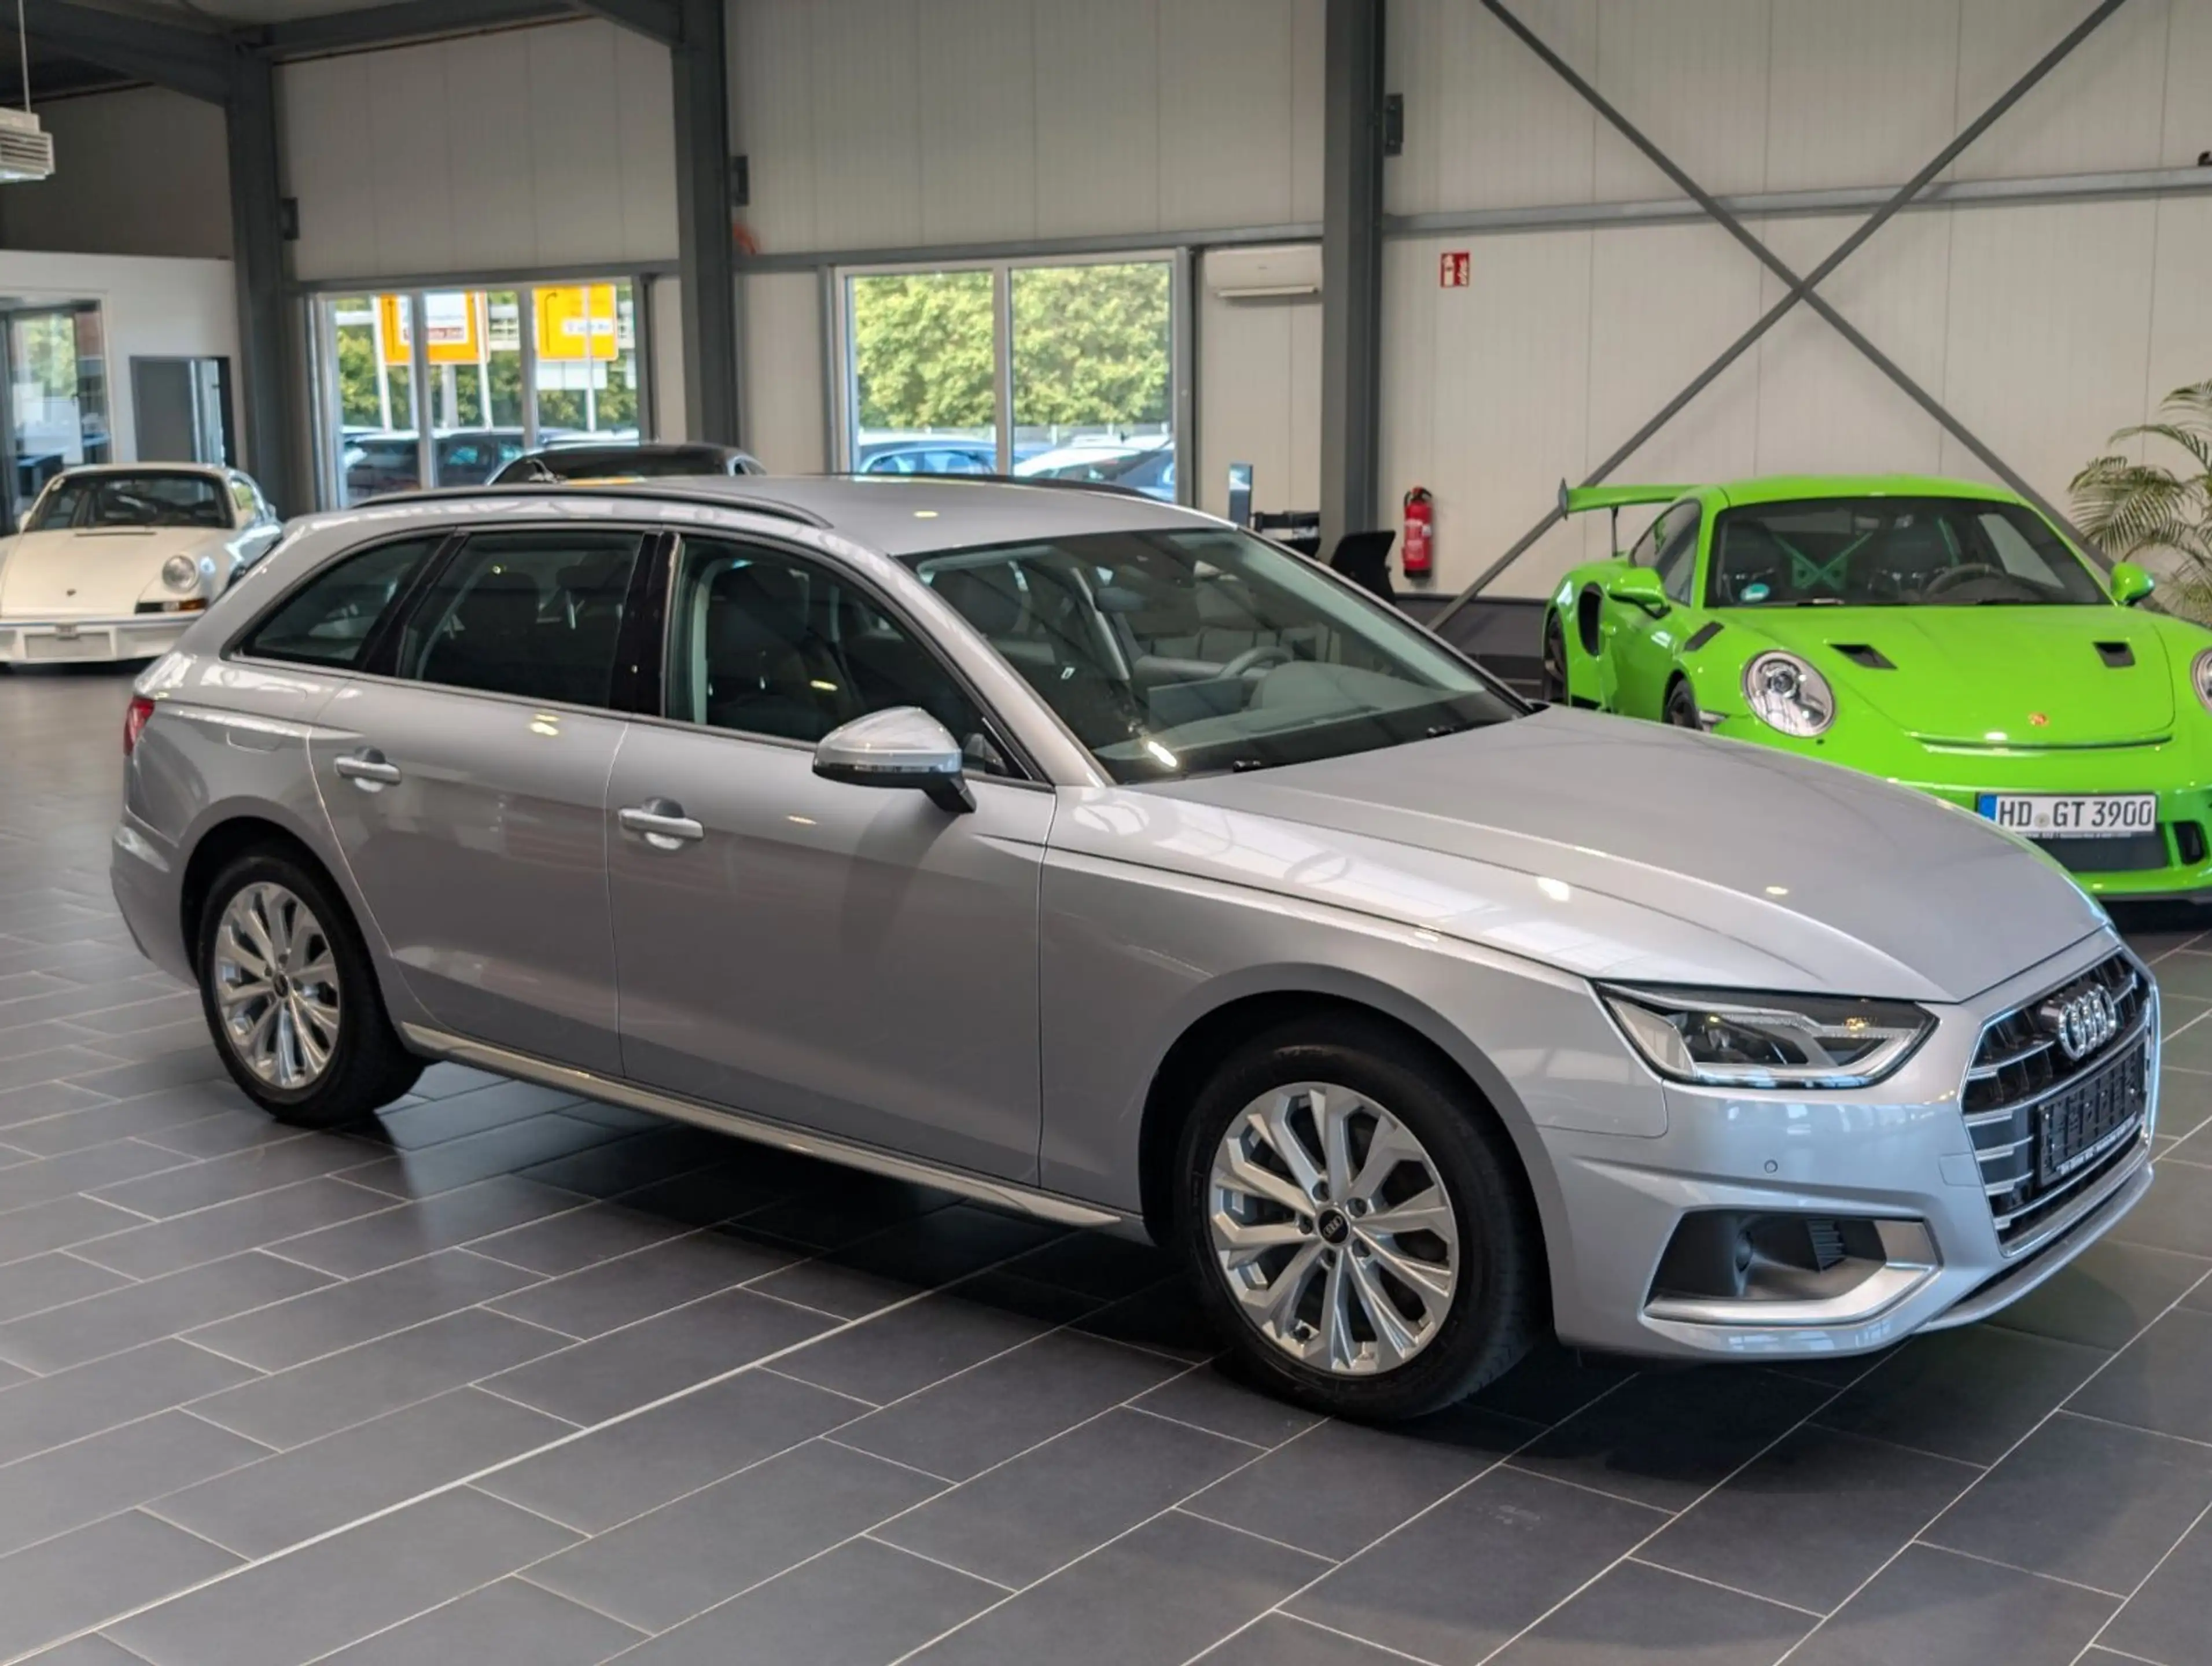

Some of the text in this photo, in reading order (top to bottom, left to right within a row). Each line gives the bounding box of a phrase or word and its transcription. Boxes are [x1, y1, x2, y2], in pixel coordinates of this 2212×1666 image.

[2000, 801, 2152, 827] HD GT 3900
